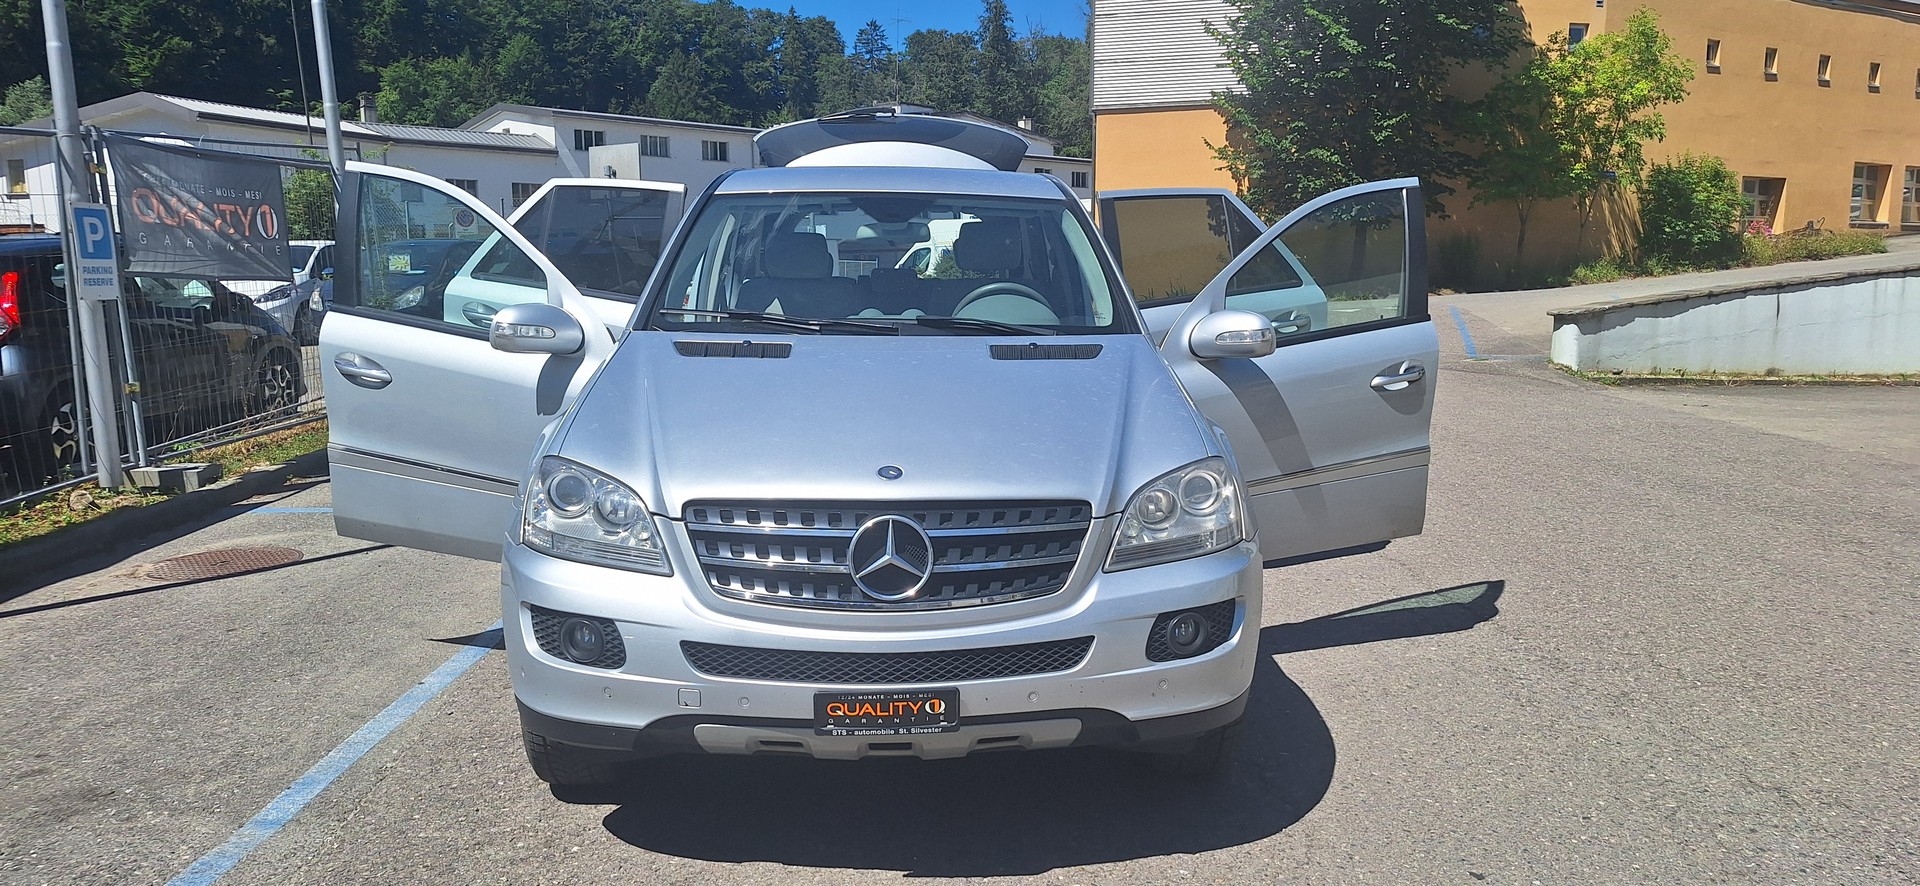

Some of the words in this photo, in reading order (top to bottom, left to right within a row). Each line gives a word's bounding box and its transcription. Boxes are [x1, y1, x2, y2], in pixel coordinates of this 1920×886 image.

[215, 187, 236, 198] MOIS
[245, 190, 262, 200] MESI
[82, 216, 105, 253] P
[139, 232, 281, 256] GARANTIE
[82, 265, 113, 275] PARKING
[826, 701, 923, 716] QUALITY
[828, 715, 945, 724] GARANTIE
[910, 726, 943, 734] Silvester
